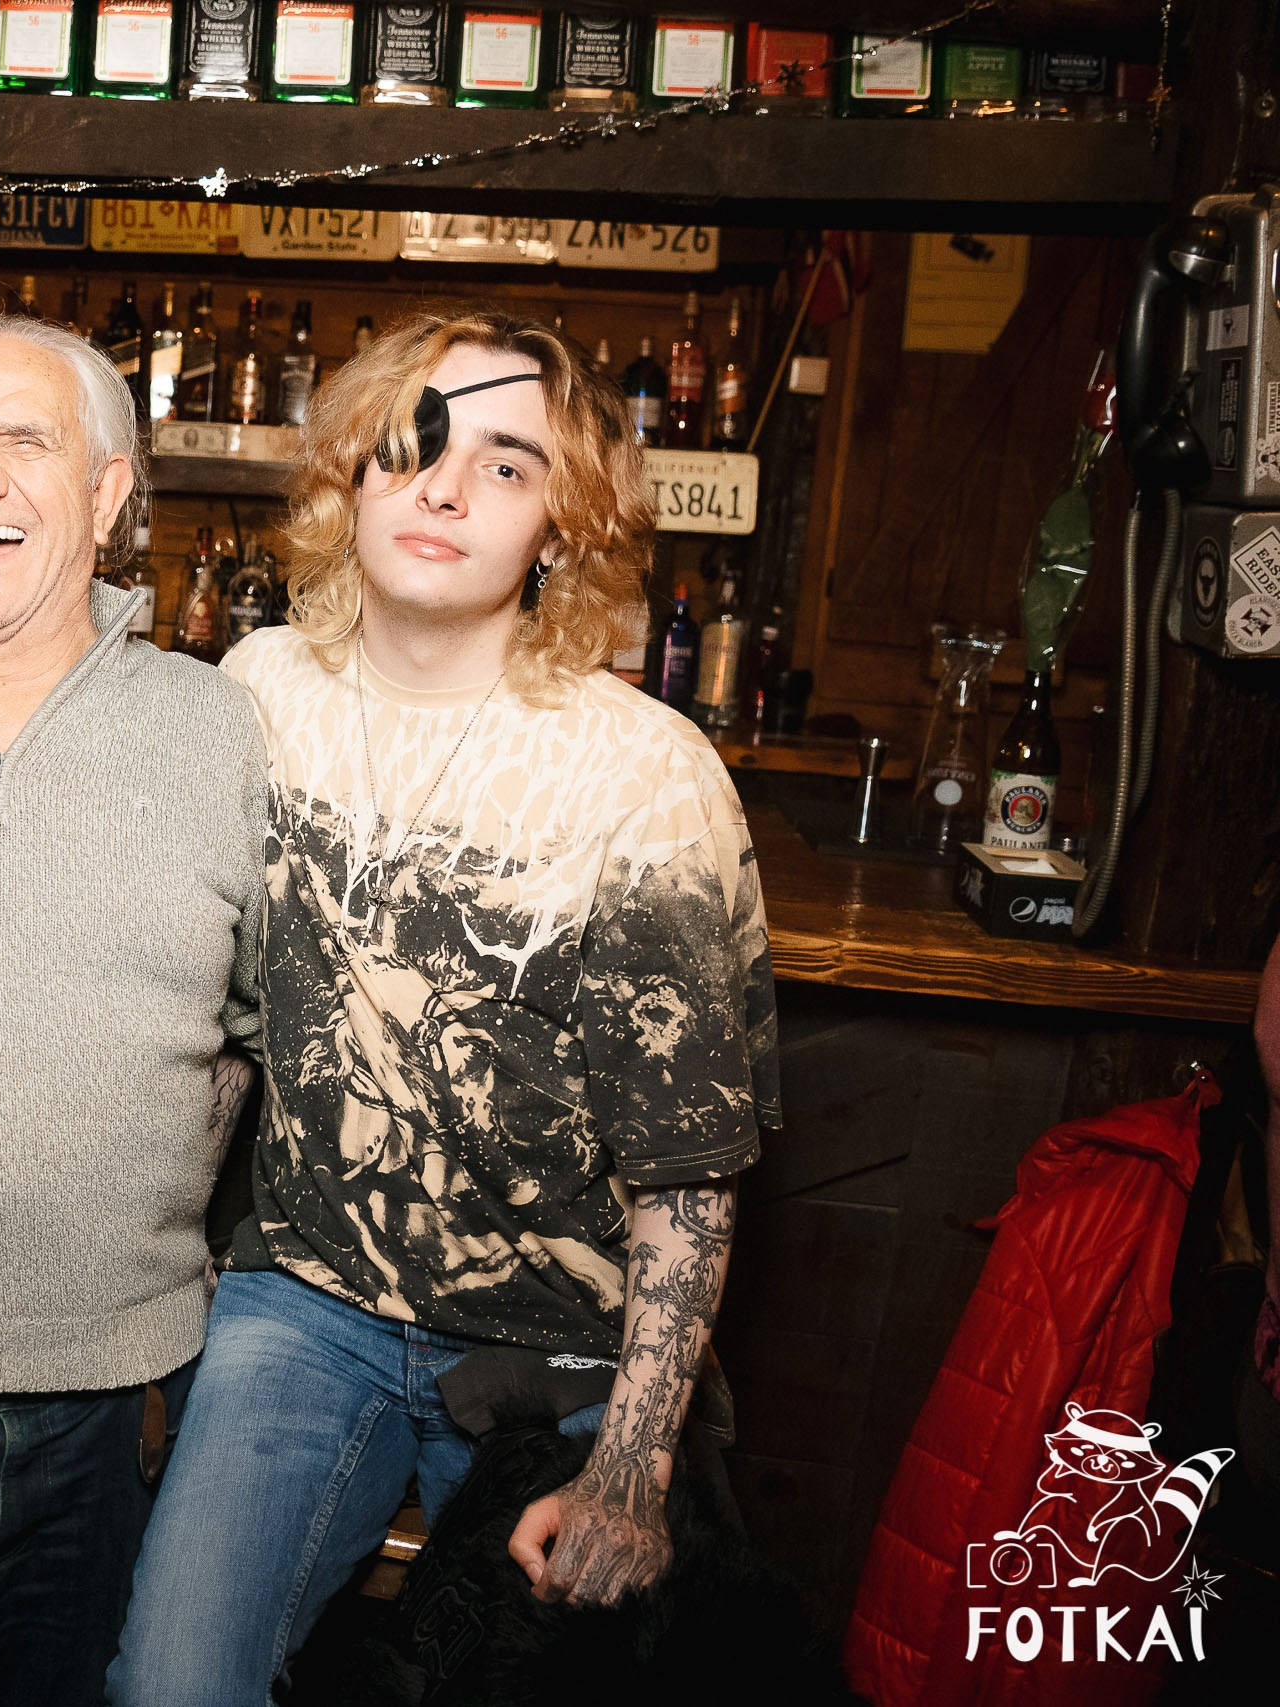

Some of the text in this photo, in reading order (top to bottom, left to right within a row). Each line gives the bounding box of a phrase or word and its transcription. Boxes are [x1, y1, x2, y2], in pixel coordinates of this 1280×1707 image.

[201, 19, 245, 31] Tennessee
[387, 24, 431, 36] Tennessee
[200, 34, 243, 43] WHISKEY
[387, 40, 429, 49] WHISKEY
[576, 45, 618, 53] WHISKEY
[282, 240, 322, 250] Garden
[1005, 787, 1047, 804] PAULANER
